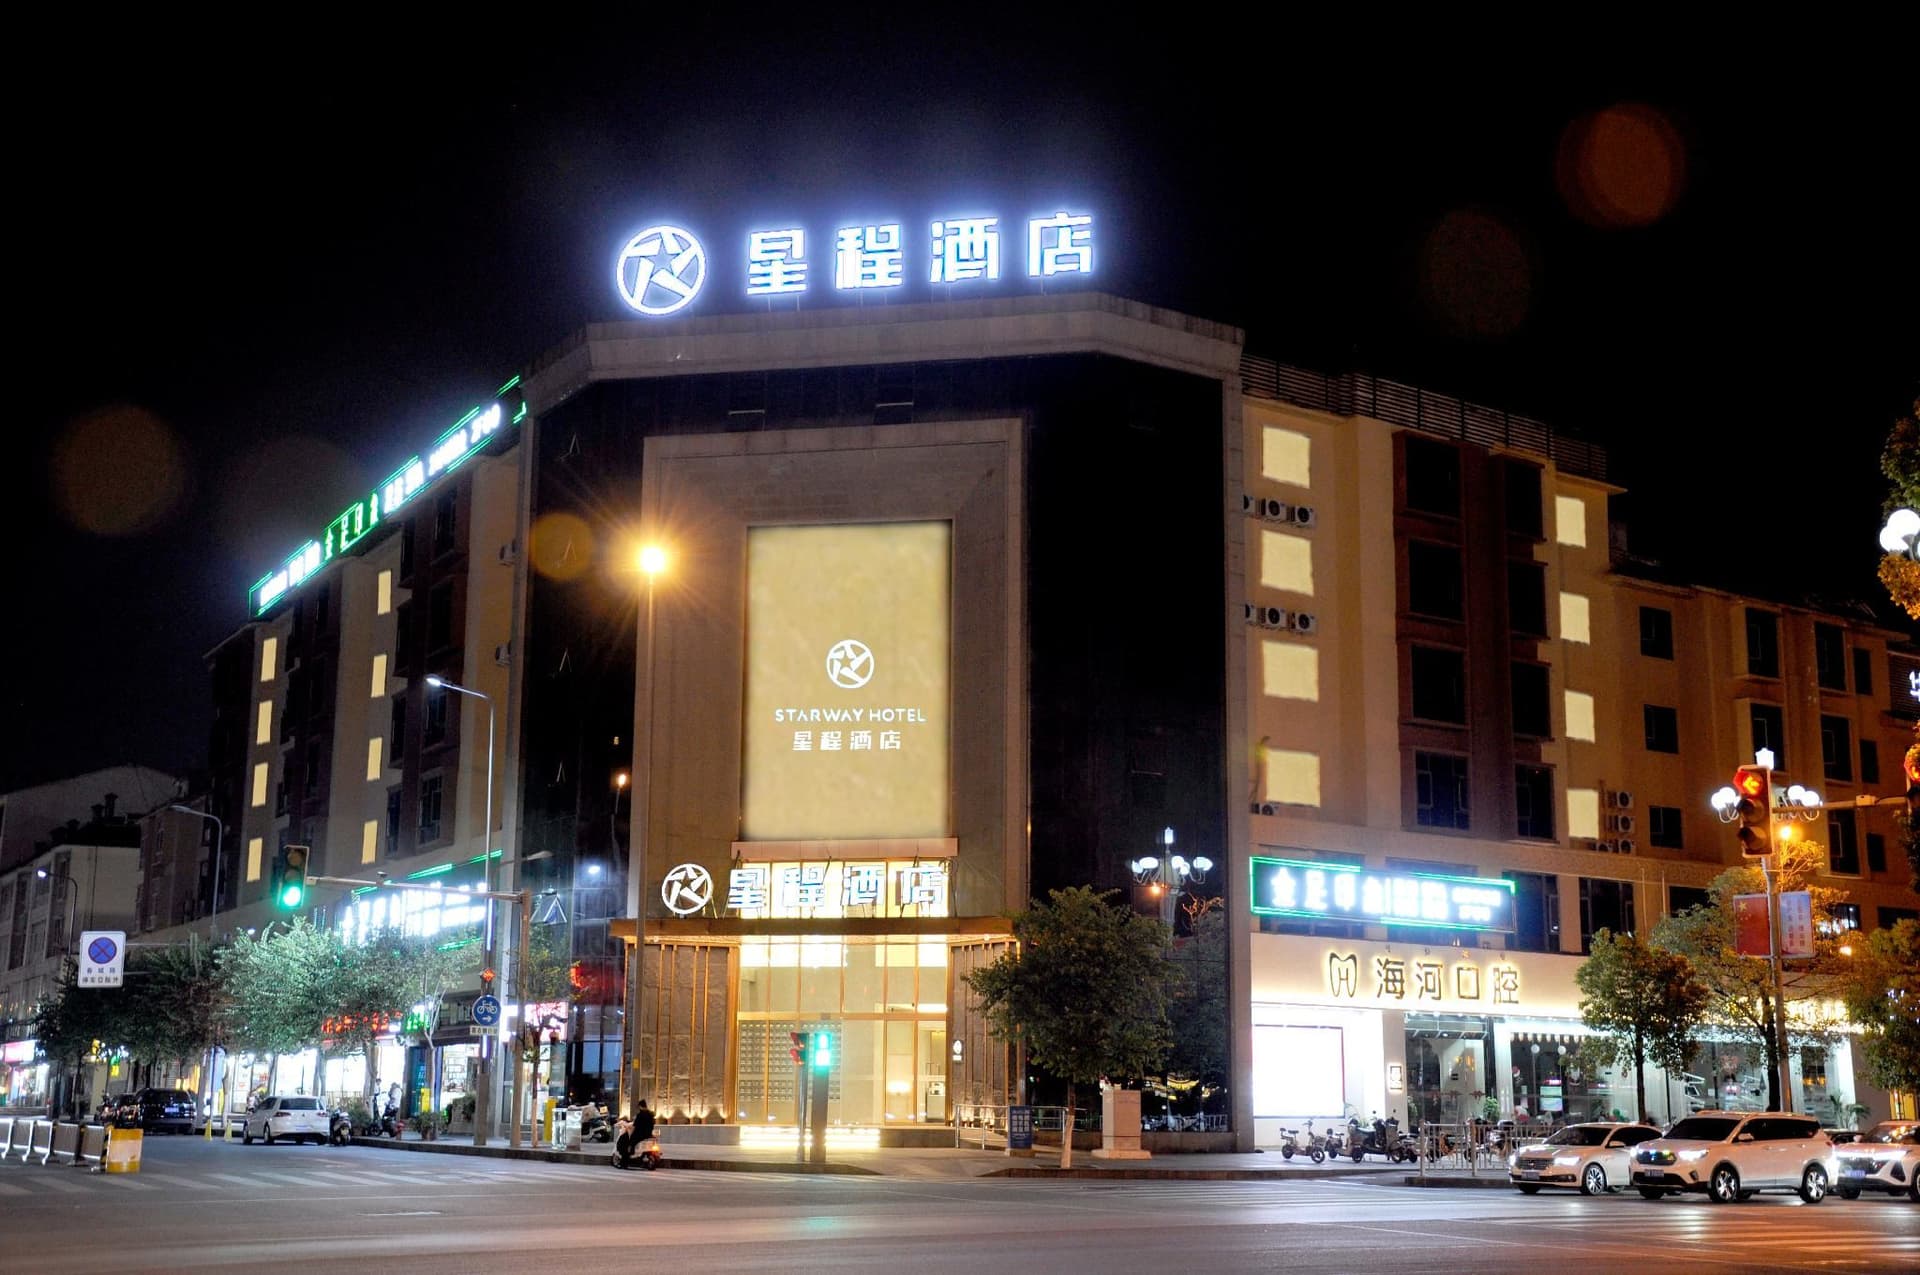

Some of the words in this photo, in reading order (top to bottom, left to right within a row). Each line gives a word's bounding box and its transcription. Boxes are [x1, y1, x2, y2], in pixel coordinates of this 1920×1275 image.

[746, 212, 1093, 296] 星程酒店
[775, 708, 864, 722] STARWAY
[869, 708, 927, 722] HOTEL
[792, 730, 901, 751] 星程酒店
[727, 865, 944, 909] 星程酒店
[1377, 957, 1520, 1005] 海河口腔
